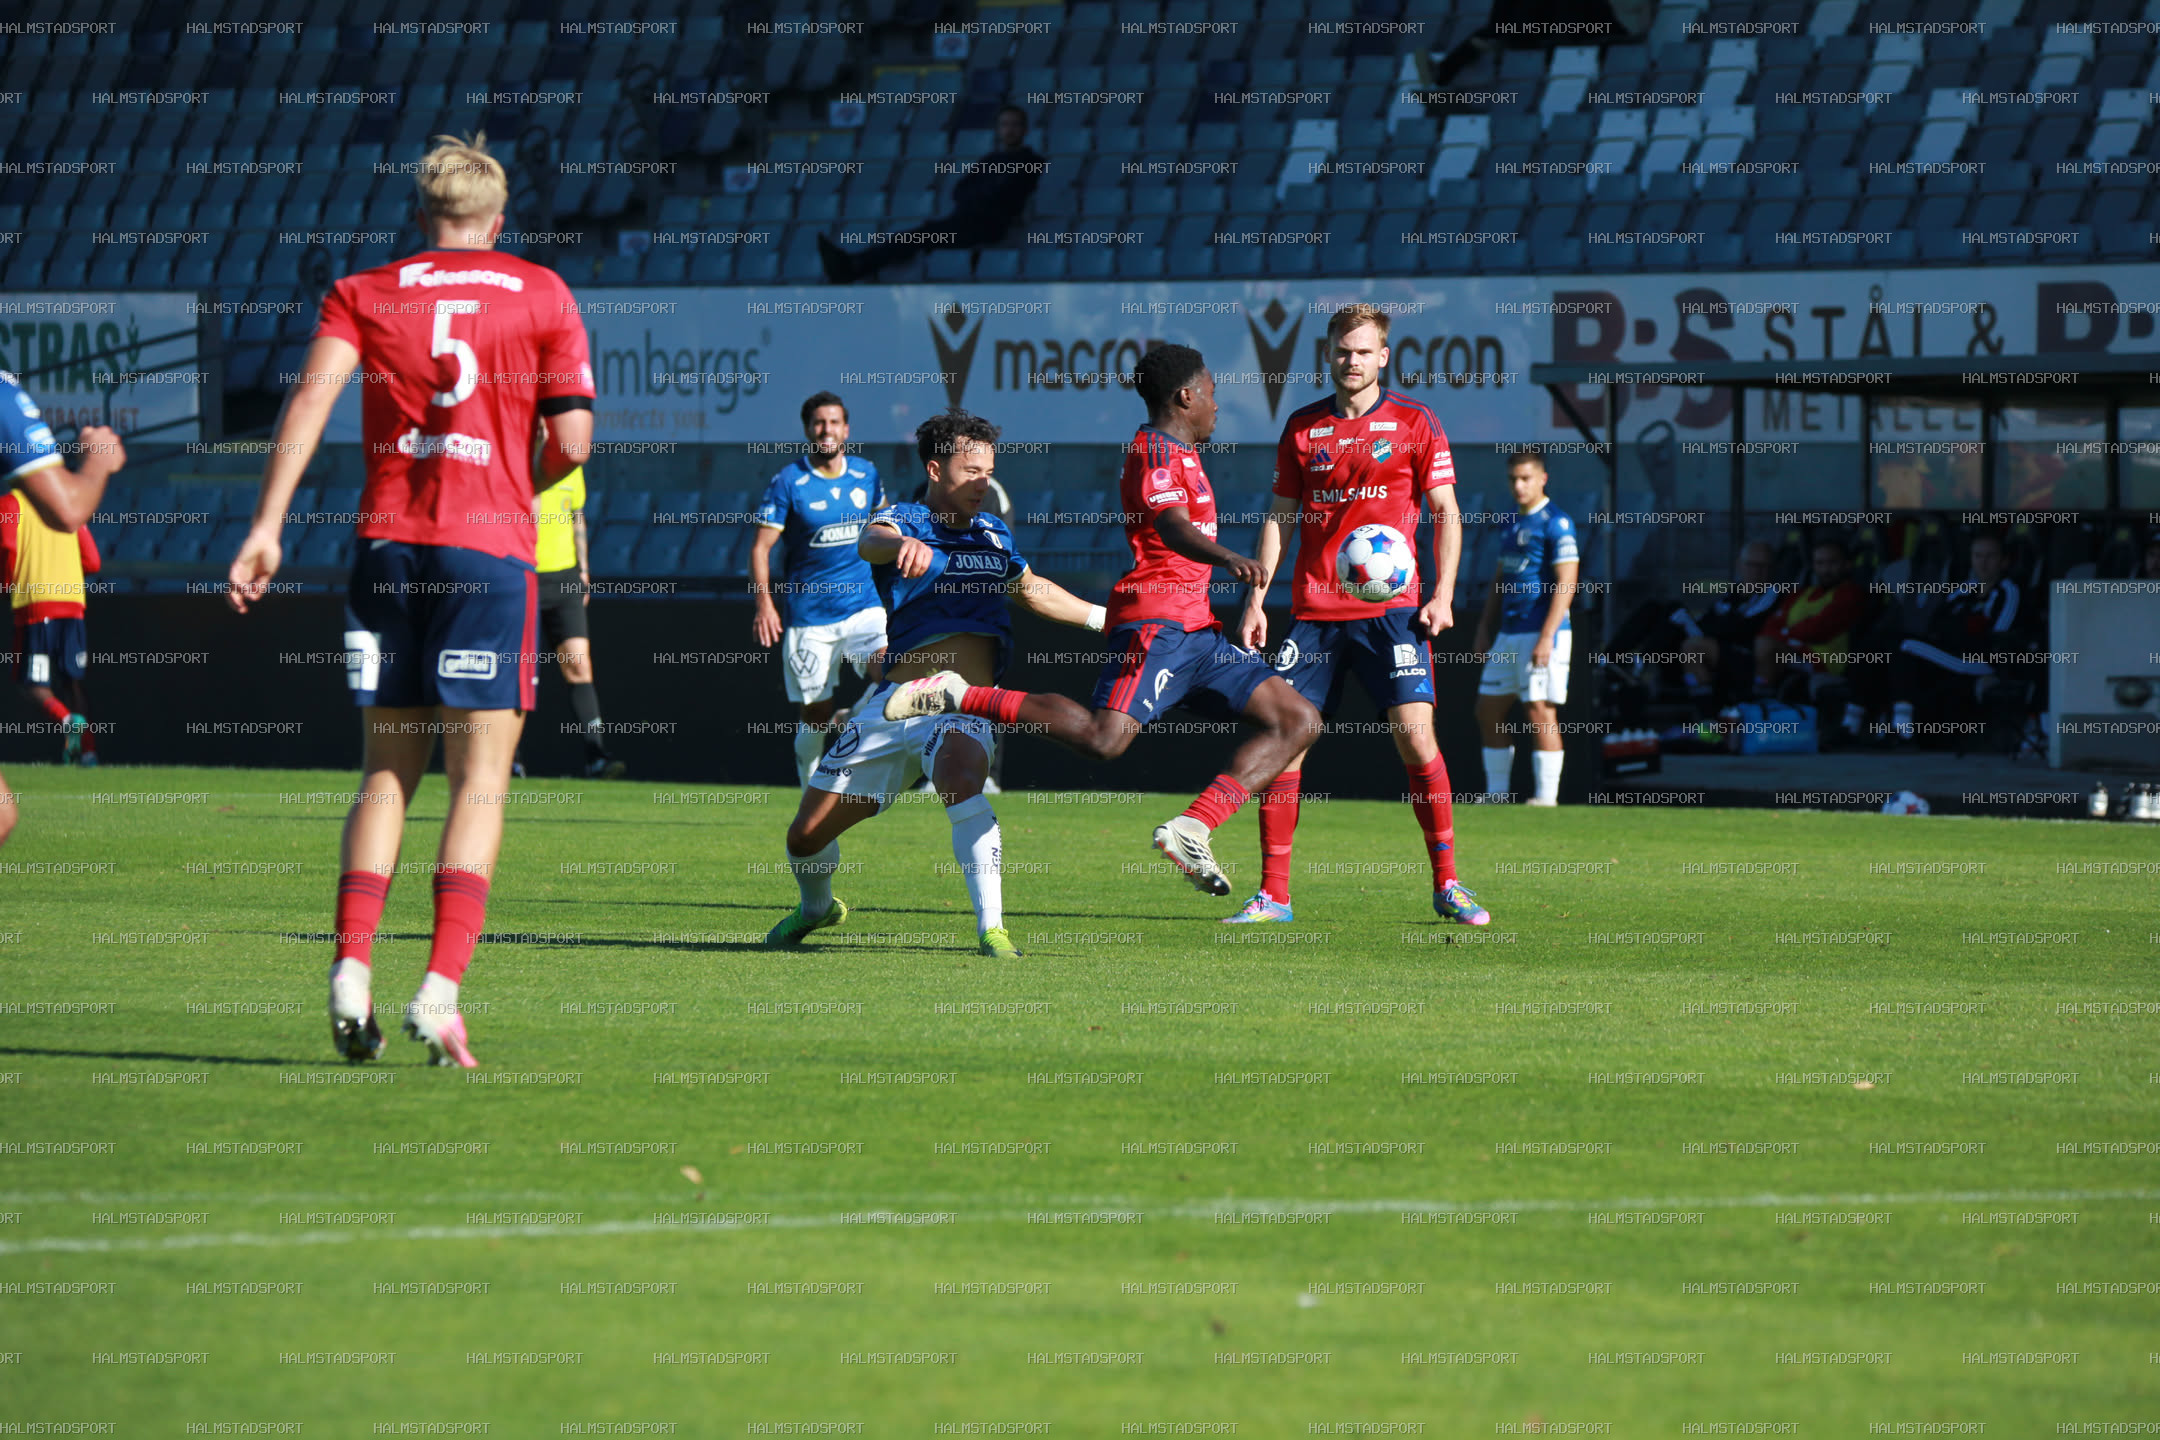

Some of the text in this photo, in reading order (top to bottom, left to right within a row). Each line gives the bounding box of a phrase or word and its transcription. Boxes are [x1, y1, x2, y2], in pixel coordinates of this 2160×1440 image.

[431, 300, 478, 407] 5
[591, 327, 760, 414] lmbergs
[993, 338, 1170, 391] macro
[1312, 485, 1388, 503] EMILSHUS
[955, 554, 1002, 571] JONAB
[1390, 668, 1427, 679] BALCO
